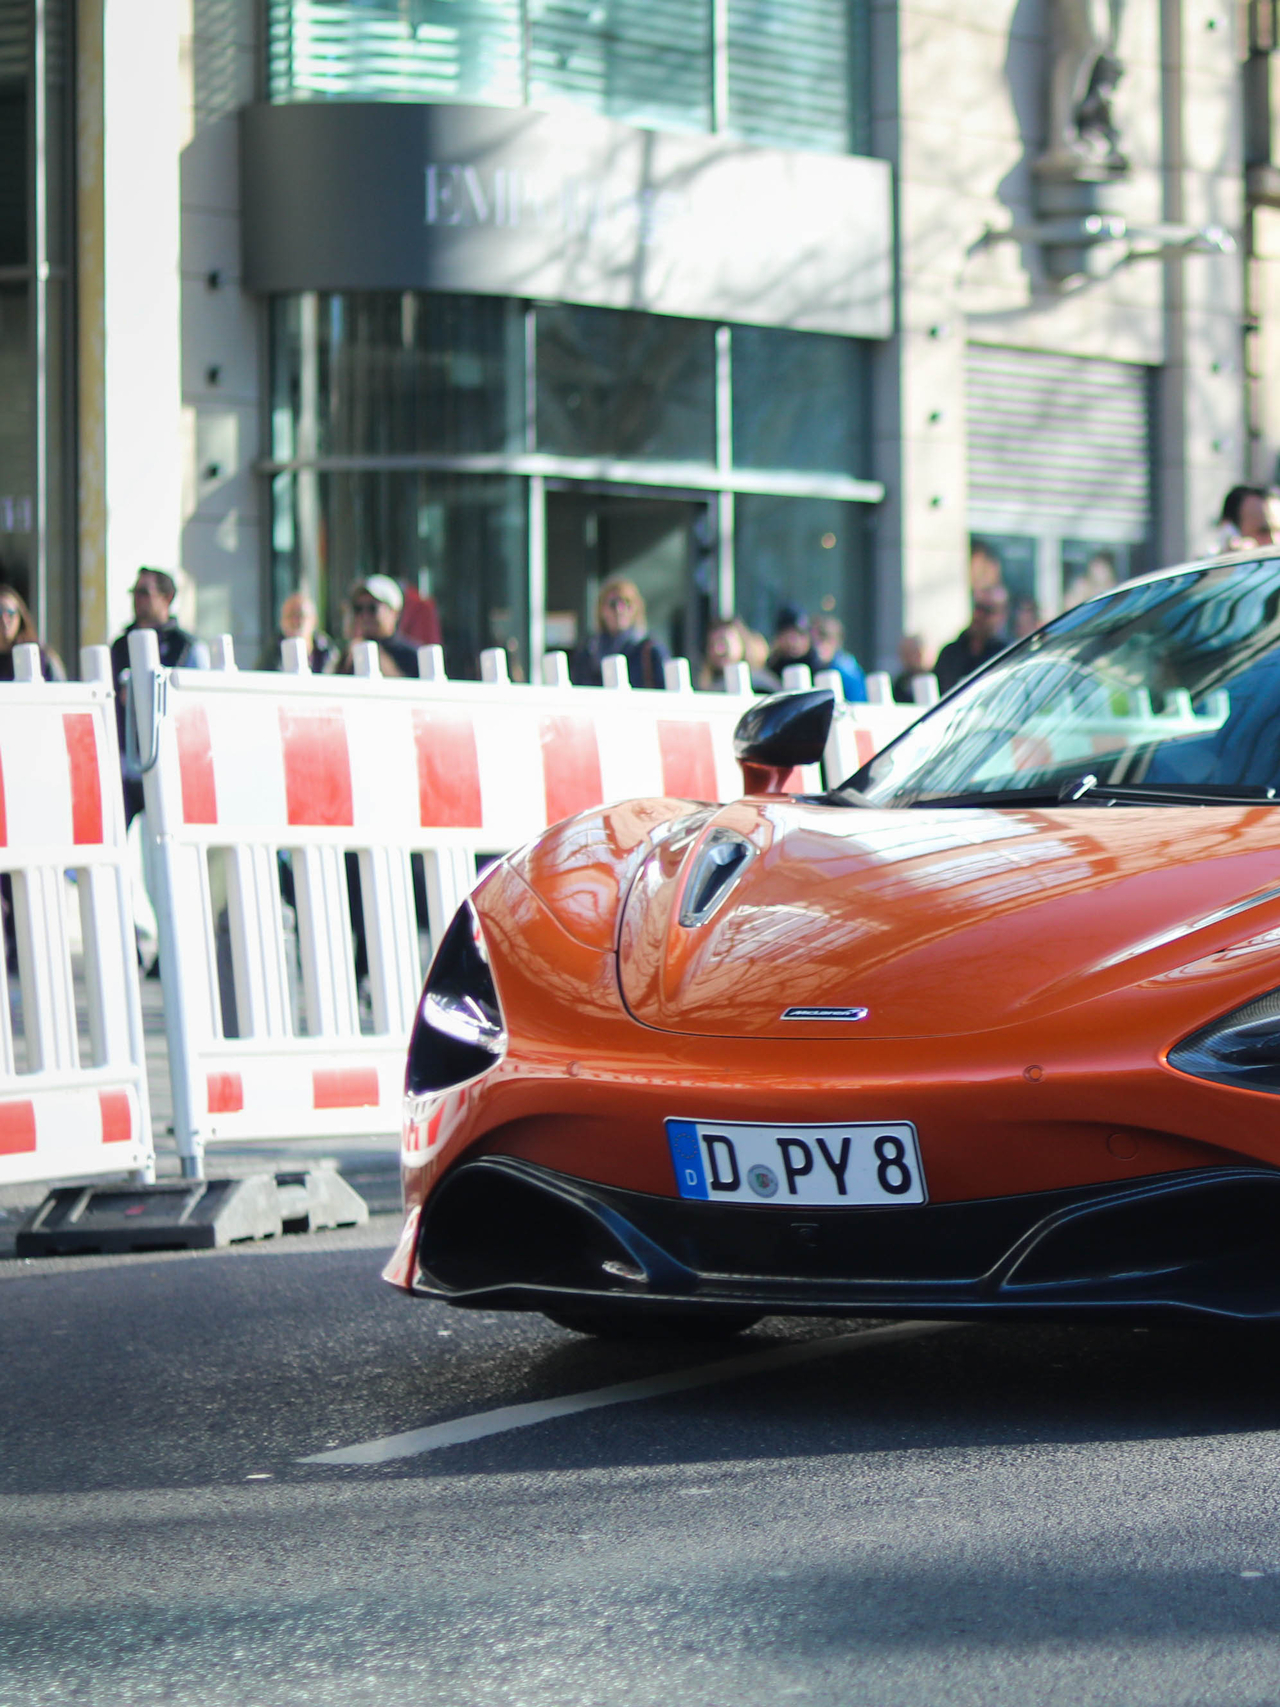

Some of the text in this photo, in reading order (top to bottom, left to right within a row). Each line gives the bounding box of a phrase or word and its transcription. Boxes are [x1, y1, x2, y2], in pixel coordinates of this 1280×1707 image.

[685, 1169, 697, 1186] D
[702, 1133, 912, 1196] D PY 8
